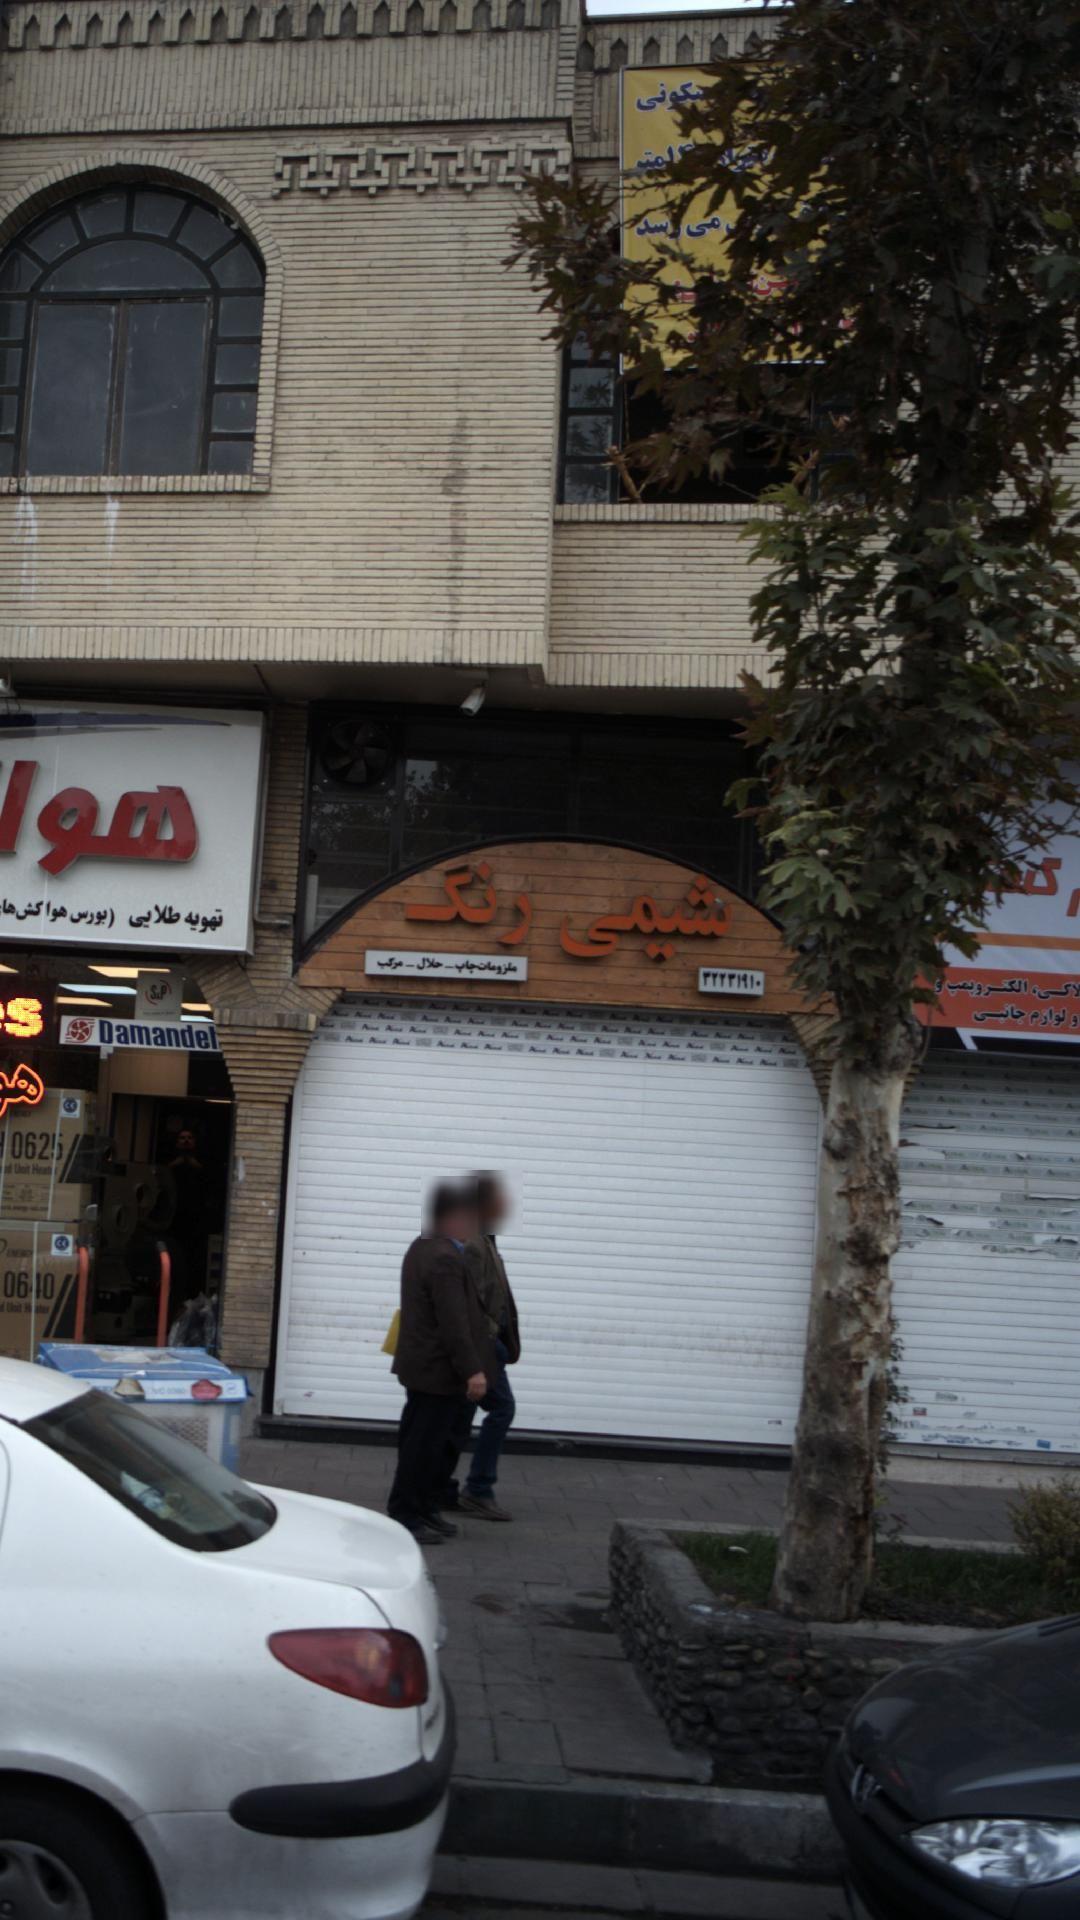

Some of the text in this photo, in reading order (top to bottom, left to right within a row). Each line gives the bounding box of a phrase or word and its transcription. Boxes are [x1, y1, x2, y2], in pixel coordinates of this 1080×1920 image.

[686, 216, 721, 238] می
[0, 760, 200, 876] هوا
[128, 904, 181, 928] طلایی
[184, 908, 224, 933] تهویه
[405, 861, 735, 963] شیمی رنگ
[973, 1004, 1026, 1024] جانبی
[1030, 1008, 1067, 1026] لوازم
[11, 1131, 64, 1161] 0625
